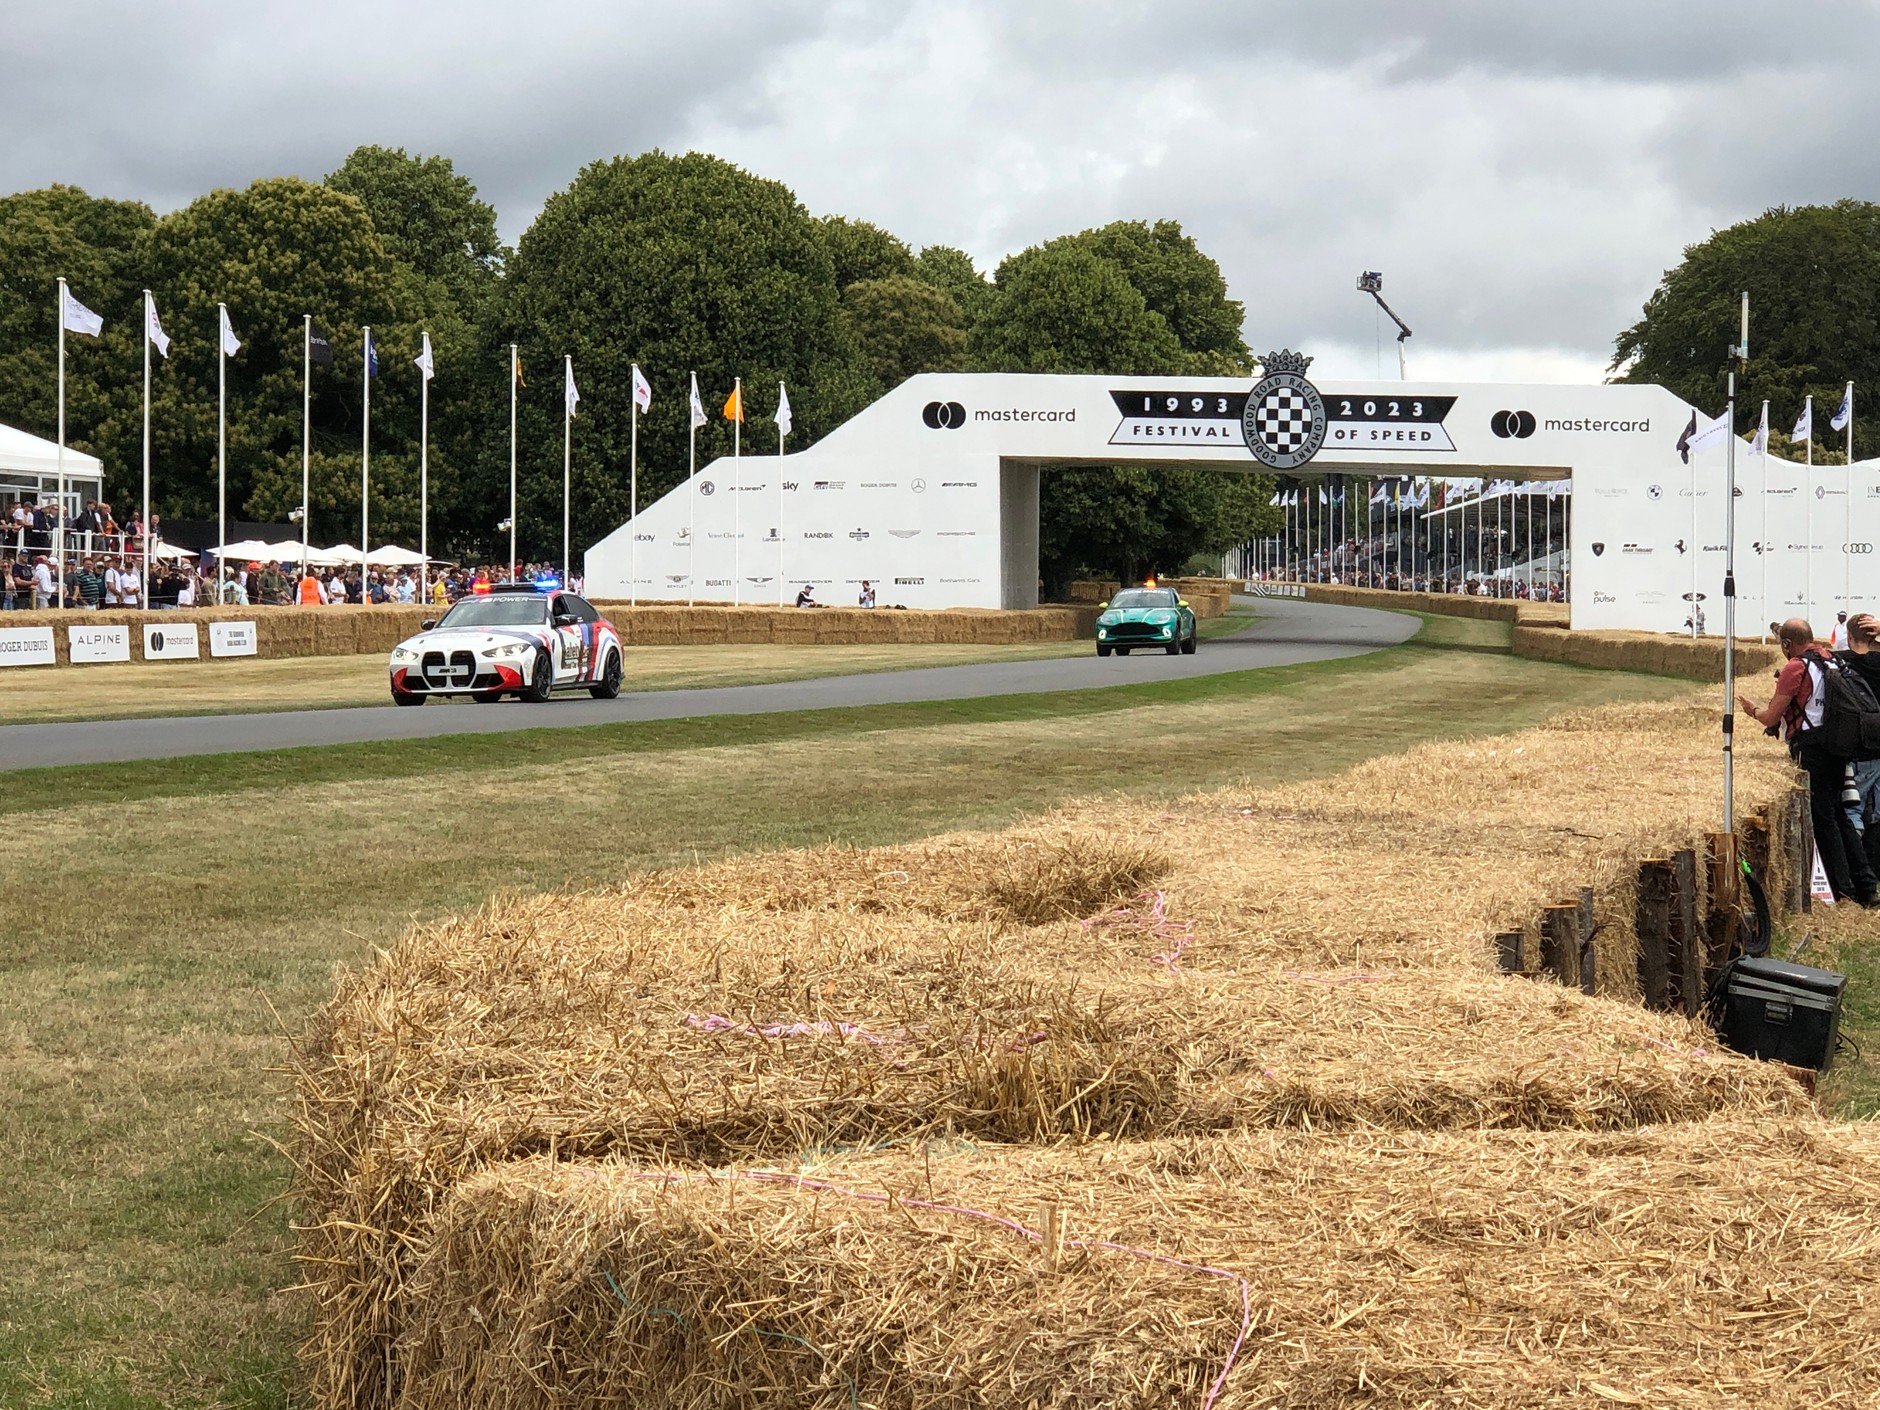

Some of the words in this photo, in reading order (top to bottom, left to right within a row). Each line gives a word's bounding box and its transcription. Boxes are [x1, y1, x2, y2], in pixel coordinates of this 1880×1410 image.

[1254, 377, 1281, 399] ROAD
[1289, 377, 1321, 411] RACING
[1144, 397, 1228, 412] 1993
[1340, 401, 1423, 417] 2023
[975, 408, 1076, 422] mastercard
[1133, 425, 1230, 437] FESTIVAL
[1545, 418, 1650, 432] mastercard
[1246, 404, 1277, 464] GOODWOOD
[1292, 417, 1323, 464] COMPANY
[1335, 429, 1358, 440] OF
[1370, 430, 1432, 441] SPEED
[782, 481, 799, 491] sky
[634, 533, 655, 542] ebay
[1594, 595, 1616, 604] pulse
[0, 641, 21, 653] OGER
[24, 640, 48, 652] DUBUIS
[77, 635, 121, 644] ALPINE
